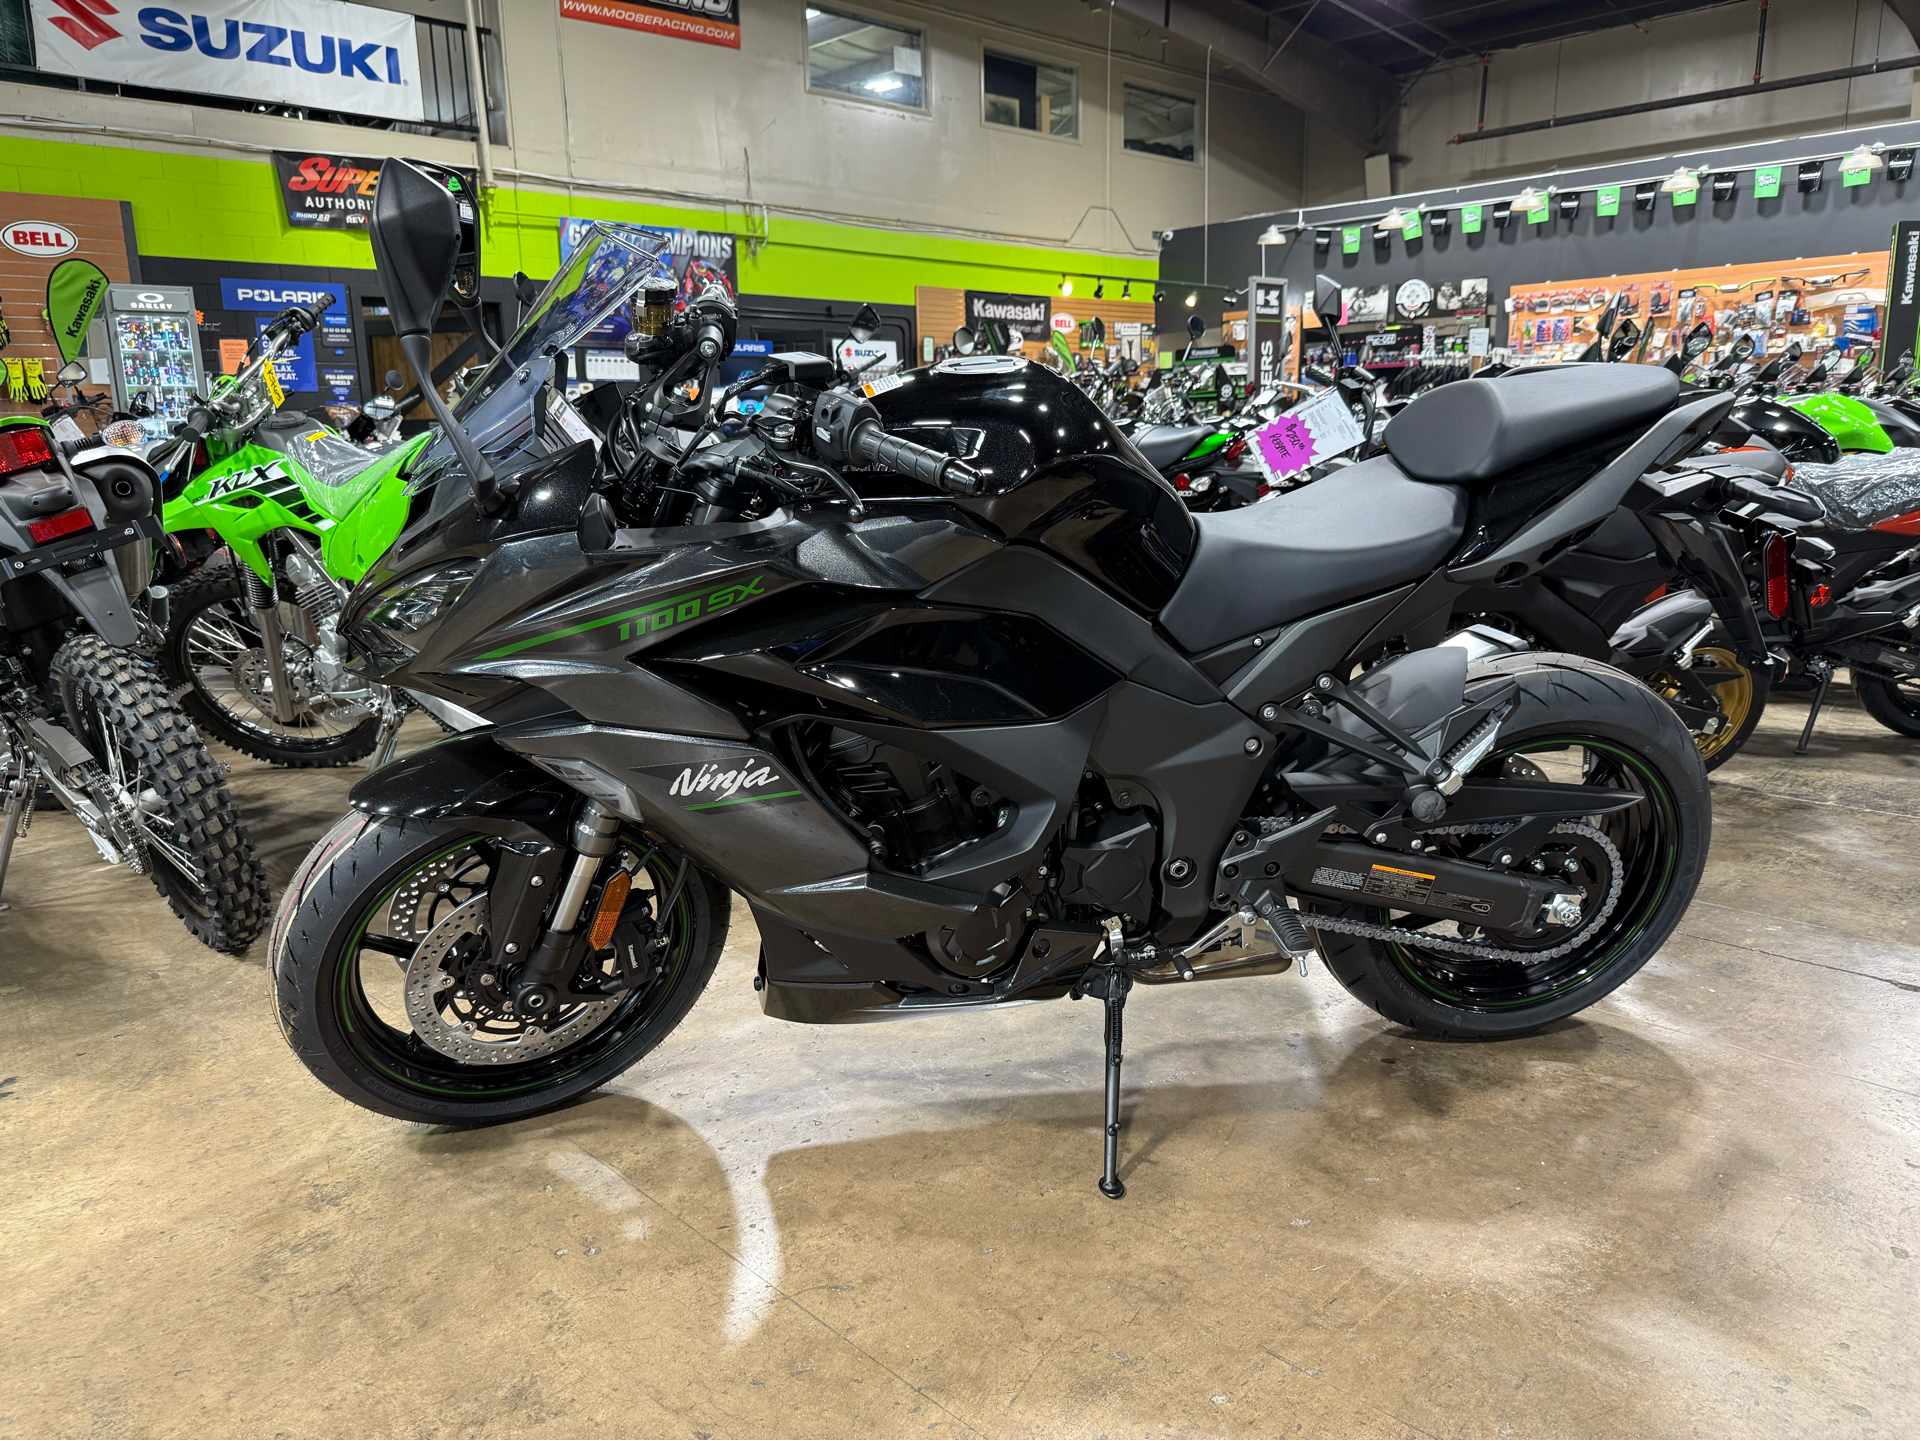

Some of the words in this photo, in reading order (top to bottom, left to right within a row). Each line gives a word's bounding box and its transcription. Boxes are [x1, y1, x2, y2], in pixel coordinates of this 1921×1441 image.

[563, 0, 735, 41] WWW.MOOSERACING.COM
[137, 7, 401, 85] SUZUKI
[305, 196, 375, 211] AUTHORI
[12, 229, 68, 249] BELL
[1901, 230, 1920, 305] Kawasaki
[65, 279, 102, 338] Kawasaki
[130, 302, 173, 310] OAKLEY
[973, 299, 1046, 321] Kawasaki
[1055, 319, 1072, 329] BELL
[1269, 433, 1292, 459] REBATE
[208, 458, 286, 499] KLX
[617, 597, 701, 642] 1100
[707, 575, 765, 613] SX
[669, 758, 781, 801] Ninja
[627, 944, 639, 969] Kawasaki
